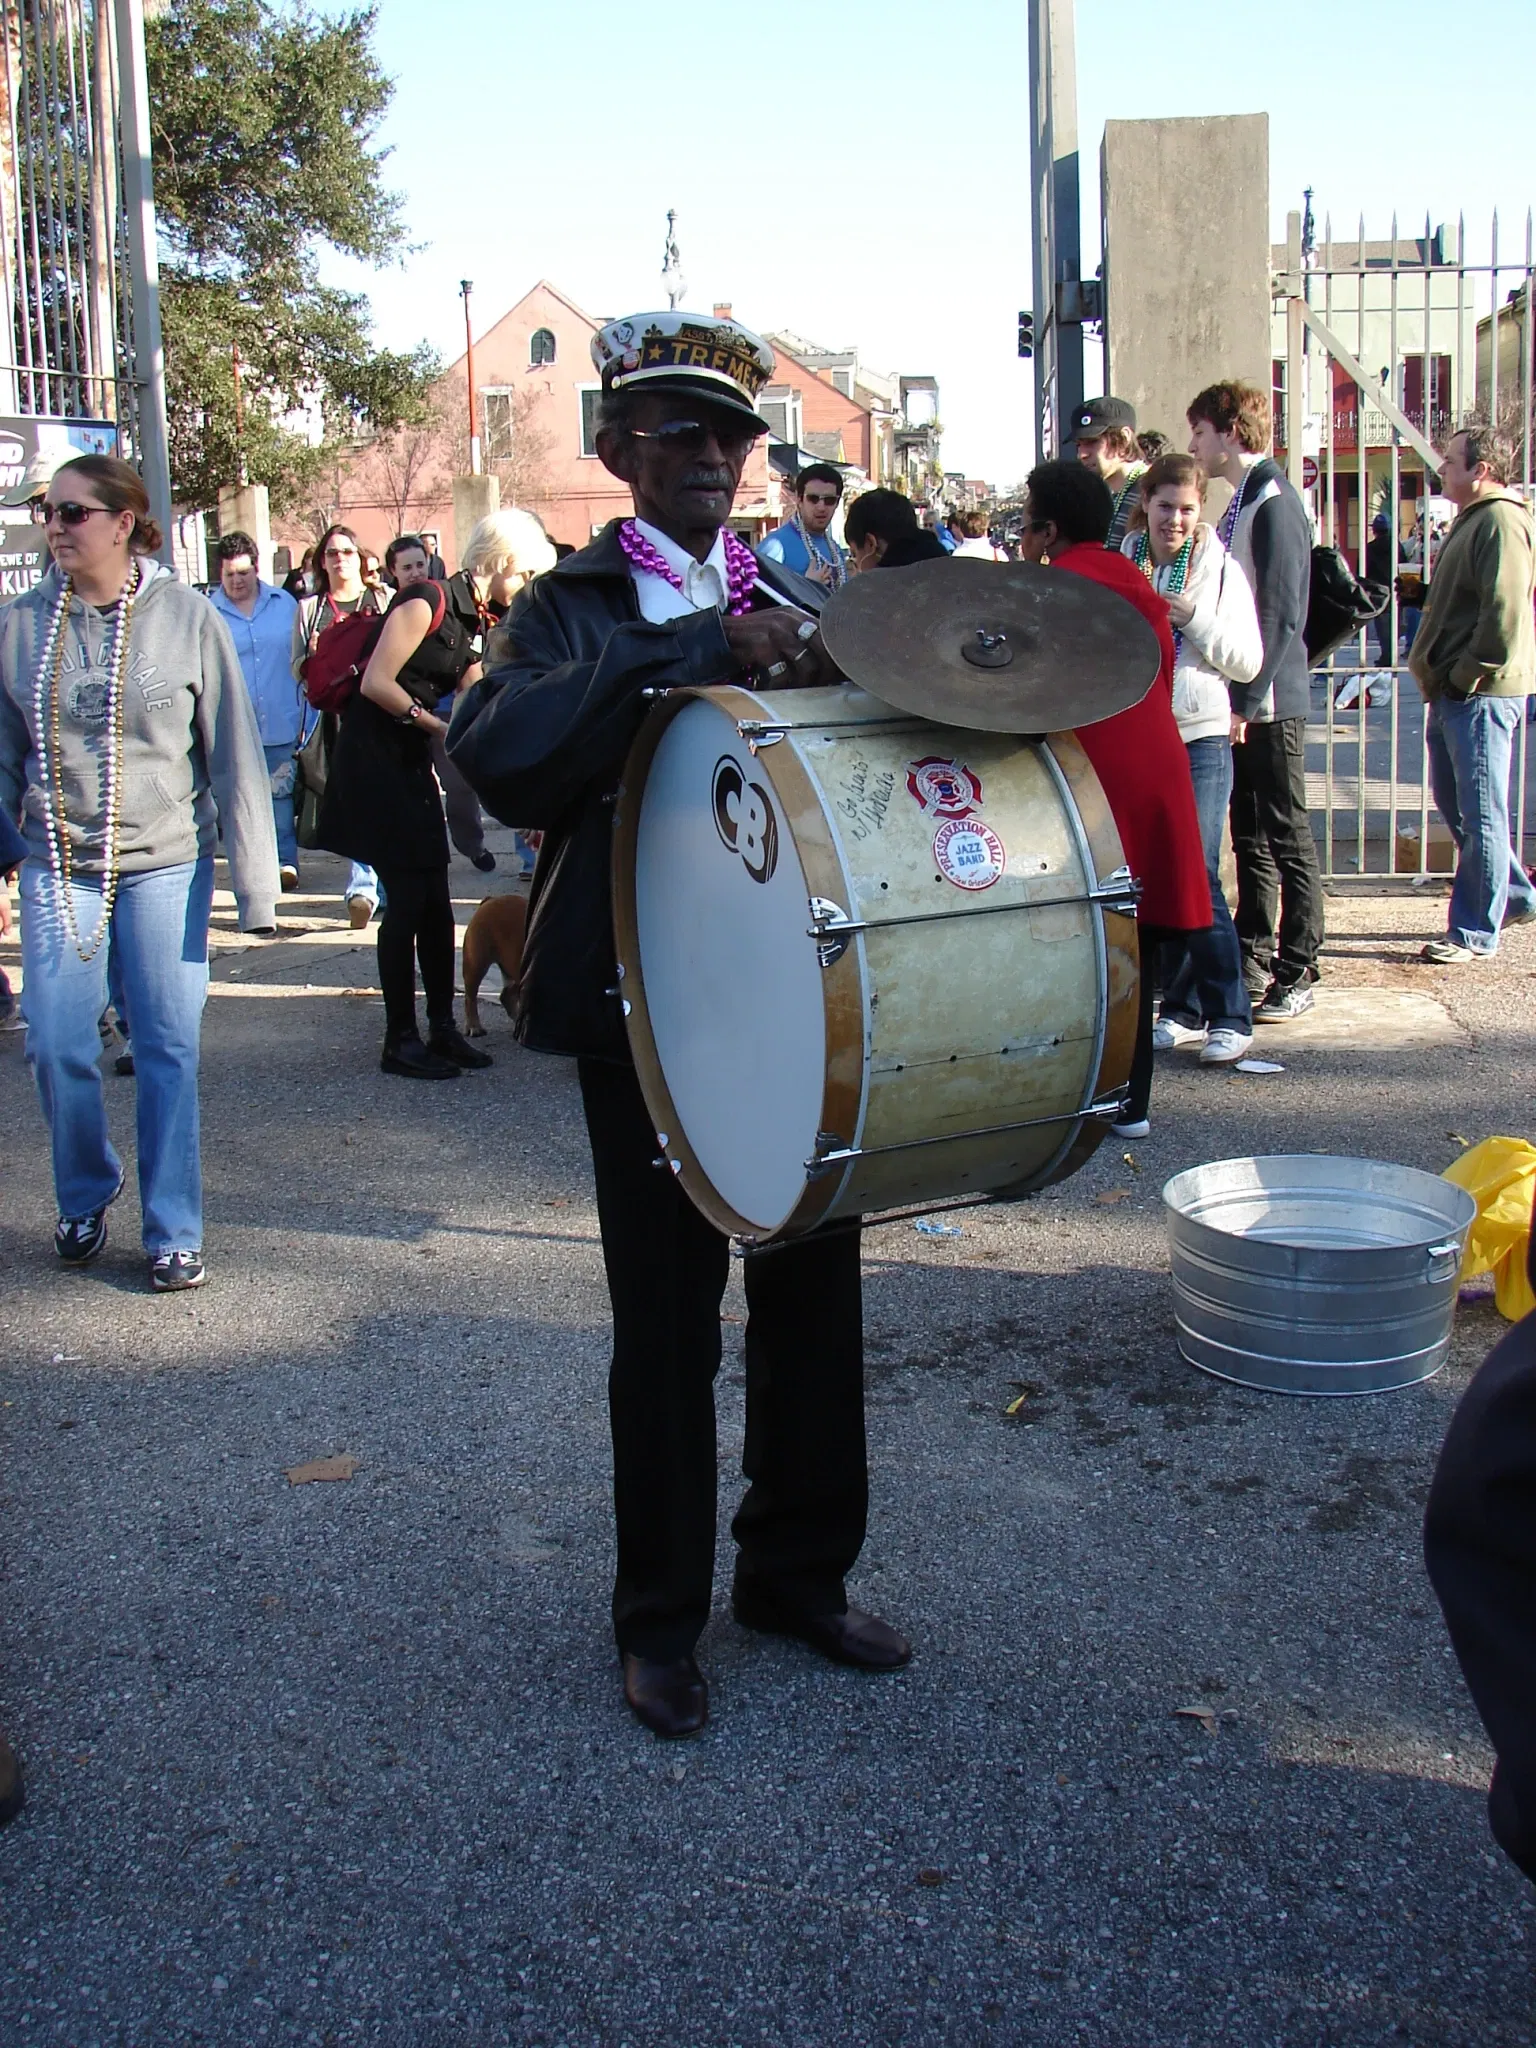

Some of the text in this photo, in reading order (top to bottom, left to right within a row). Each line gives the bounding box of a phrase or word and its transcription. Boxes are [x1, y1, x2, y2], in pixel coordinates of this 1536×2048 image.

[671, 342, 752, 388] TREME
[25, 552, 39, 565] OF
[0, 569, 43, 595] KUS
[937, 821, 1002, 872] PRESERVATION HALL
[955, 842, 982, 855] JAZZ
[957, 854, 986, 866] BAND
